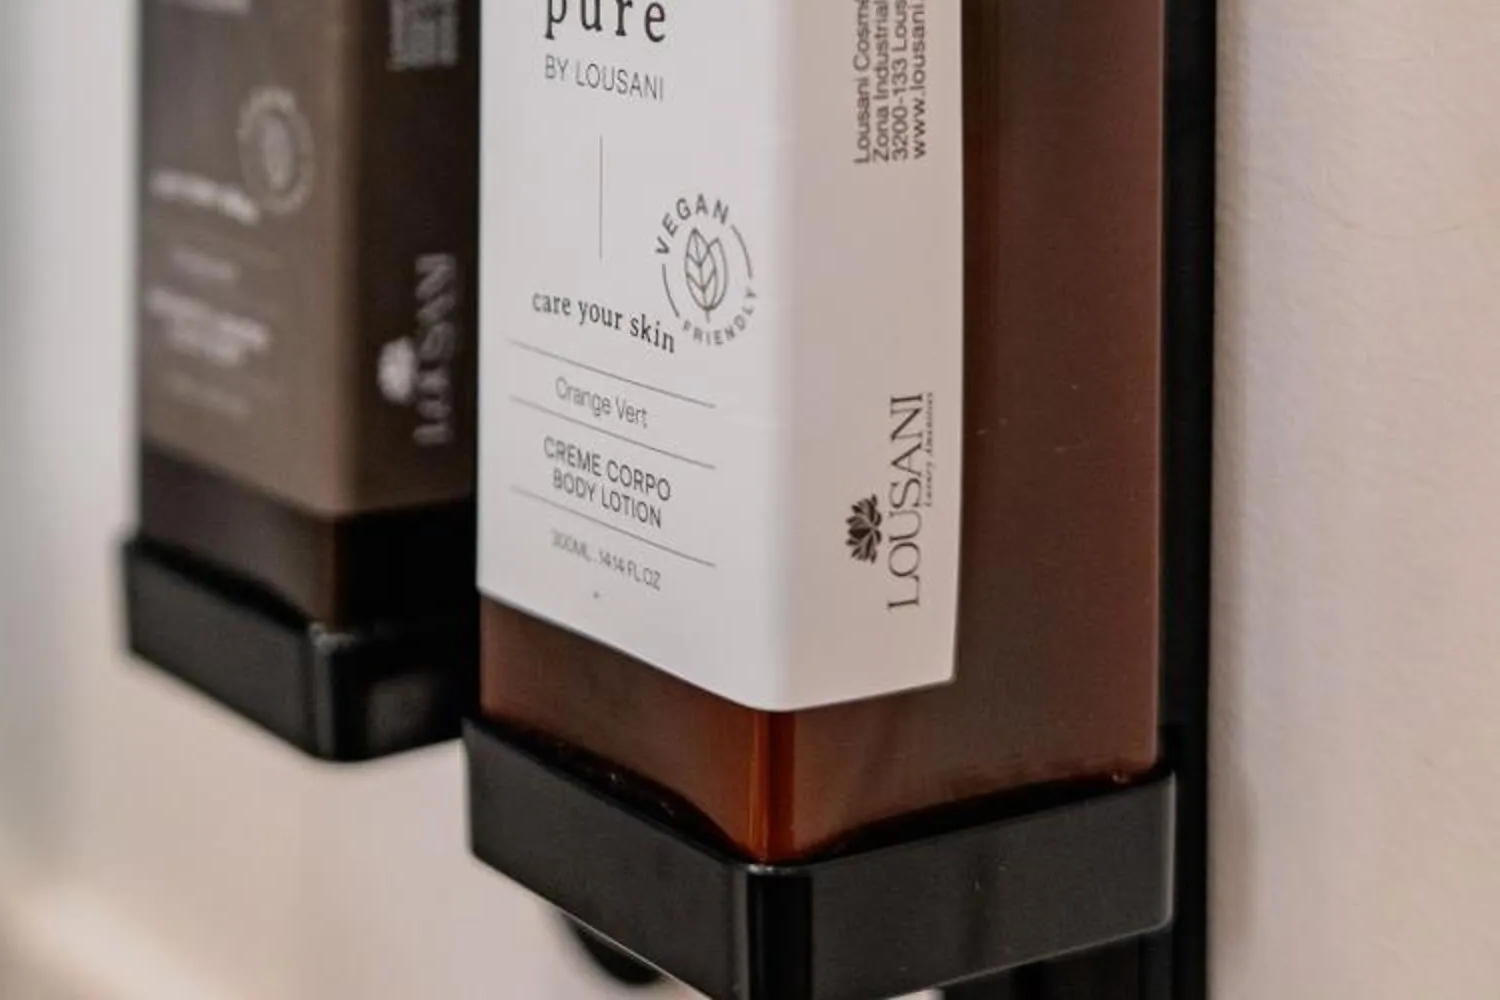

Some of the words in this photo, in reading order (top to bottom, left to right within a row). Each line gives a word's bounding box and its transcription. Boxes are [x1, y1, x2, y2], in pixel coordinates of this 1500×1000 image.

[544, 54, 569, 82] BY
[576, 60, 665, 101] LOUSANI
[872, 0, 889, 100] Industrial
[852, 77, 871, 164] Lousani
[872, 105, 889, 163] Zona
[891, 58, 908, 162] 3200-133
[654, 193, 729, 256] VEGAN
[531, 290, 571, 316] care
[578, 300, 623, 331] your
[630, 313, 676, 354] skin
[682, 288, 758, 346] FRIENDLY
[555, 375, 611, 417] Orange
[543, 435, 602, 477] CREME
[607, 459, 671, 502] CORPO
[552, 469, 597, 501] BODY
[601, 486, 662, 529] LOTION
[887, 393, 923, 611] LOUSANI
